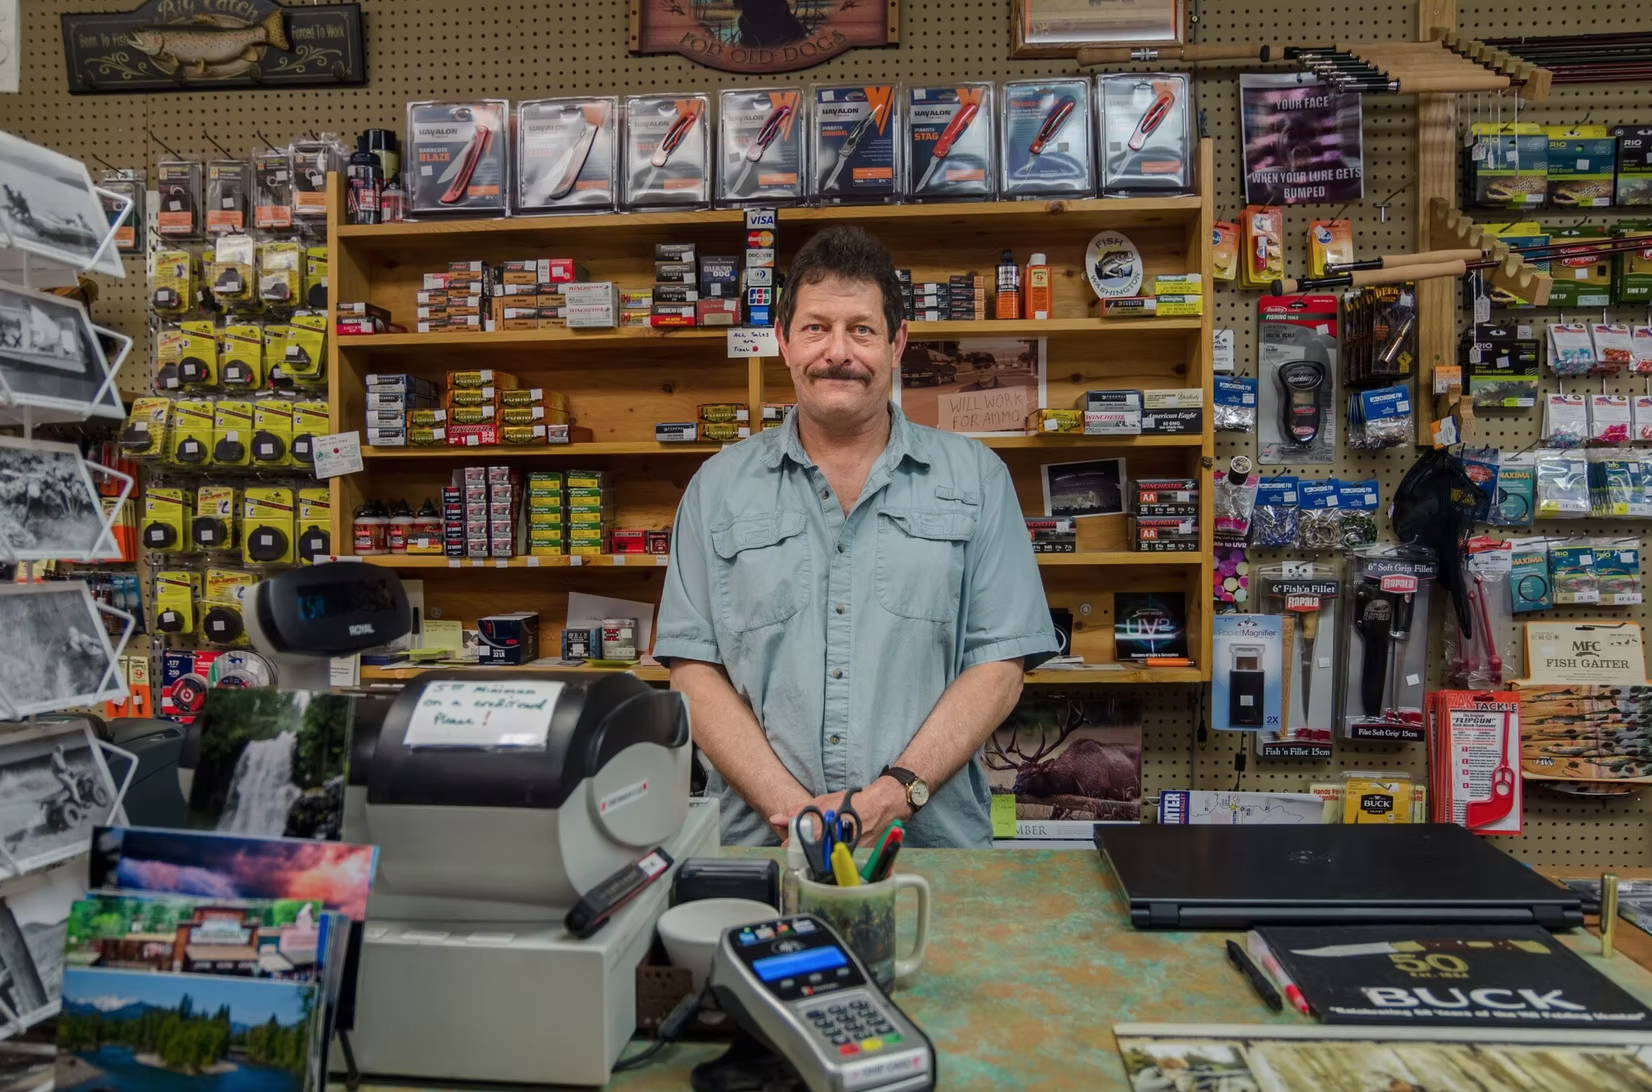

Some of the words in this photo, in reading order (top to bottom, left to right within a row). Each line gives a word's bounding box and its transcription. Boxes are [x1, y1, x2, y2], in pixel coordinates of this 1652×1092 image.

[203, 0, 259, 20] atch
[315, 24, 325, 39] To
[326, 23, 345, 39] Work
[731, 48, 775, 65] OLD
[1275, 97, 1302, 110] YOUR
[1304, 96, 1329, 108] FACE
[822, 108, 859, 116] HAVALON
[419, 128, 458, 136] HAVALON
[914, 132, 939, 141] STAG
[419, 152, 450, 162] BLAZE
[1251, 172, 1279, 184] WHEN
[1279, 171, 1307, 183] YOUR
[1308, 169, 1333, 182] LURE
[1335, 167, 1361, 180] GETS
[1283, 185, 1326, 199] BUMPED
[750, 216, 774, 225] VISA
[1095, 237, 1124, 250] FISH
[1091, 272, 1141, 296] WASHINGTON
[750, 289, 770, 304] JCB
[1375, 288, 1399, 298] DEER
[949, 396, 980, 413] WILL
[983, 391, 1024, 408] WORK
[952, 413, 979, 429] FOR
[982, 409, 1021, 425] AMMO
[1143, 493, 1154, 501] AA
[1143, 530, 1155, 538] AA
[1512, 557, 1543, 565] MAXIMA
[1377, 563, 1393, 572] Soft
[1394, 564, 1412, 573] Grip
[1414, 564, 1433, 573] Fillet
[1272, 585, 1282, 593] 6"
[1311, 585, 1335, 593] Fillet
[349, 624, 375, 636] ROYAL
[1572, 641, 1601, 652] MFC
[1546, 659, 1577, 668] FISH
[1581, 660, 1630, 669] GAITER
[1358, 728, 1371, 736] Filet
[1372, 729, 1384, 737] Soft
[1385, 729, 1399, 739] Grip
[1402, 730, 1417, 738] 15cm
[1265, 747, 1279, 756] Fish
[1290, 748, 1308, 756] Fillet
[1311, 748, 1330, 756] 15cm
[1164, 793, 1180, 824] INTER
[1015, 826, 1047, 835] MBER
[1388, 953, 1470, 973] 50
[1361, 986, 1587, 1009] BUCK
